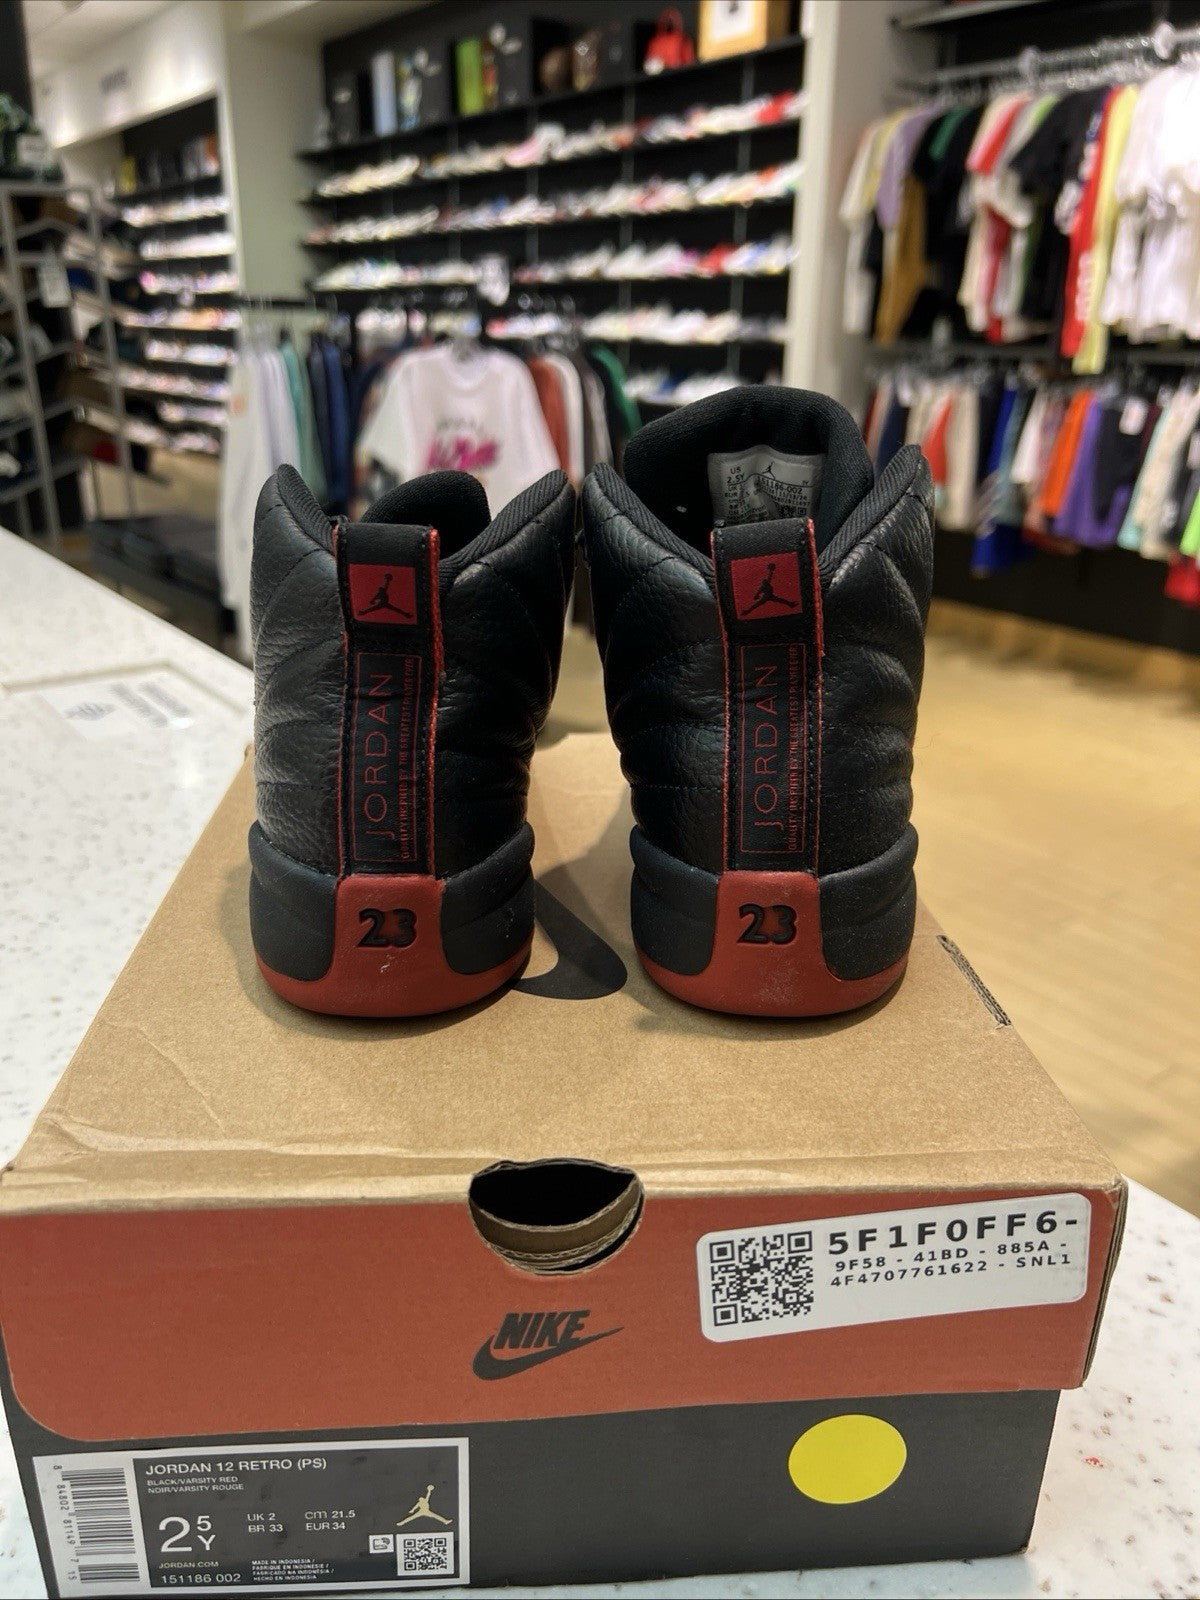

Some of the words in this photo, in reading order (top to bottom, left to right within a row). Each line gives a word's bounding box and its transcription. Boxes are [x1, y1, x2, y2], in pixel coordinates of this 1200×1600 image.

[730, 466, 742, 474] US
[362, 671, 395, 841] JORDAN
[751, 663, 784, 832] JORDAN
[357, 907, 418, 948] 23
[736, 903, 798, 945] 23
[828, 1210, 1078, 1255] 5F1F0FF6-
[494, 1309, 591, 1350] NIKE
[145, 1462, 212, 1475] JORDAN
[216, 1462, 234, 1472] 12
[239, 1459, 293, 1471] RETRO
[297, 1457, 327, 1471] (PS)
[147, 1477, 216, 1486] BLACK/VARSITY
[148, 1485, 210, 1494] NOIR/VARSITY
[212, 1483, 244, 1491] ROUGE
[57, 1484, 69, 1511] 84802
[63, 1519, 76, 1545] 81149
[247, 1513, 264, 1521] UK
[268, 1512, 276, 1521] 2
[331, 1509, 356, 1519] 21.5
[197, 1515, 212, 1531] 5
[248, 1524, 265, 1533] BR
[269, 1523, 283, 1532] 33
[306, 1521, 330, 1531] EUR
[332, 1521, 346, 1530] 34
[159, 1516, 192, 1552] 2
[197, 1534, 216, 1551] Y
[162, 1573, 212, 1584] 151186
[215, 1572, 241, 1583] 002
